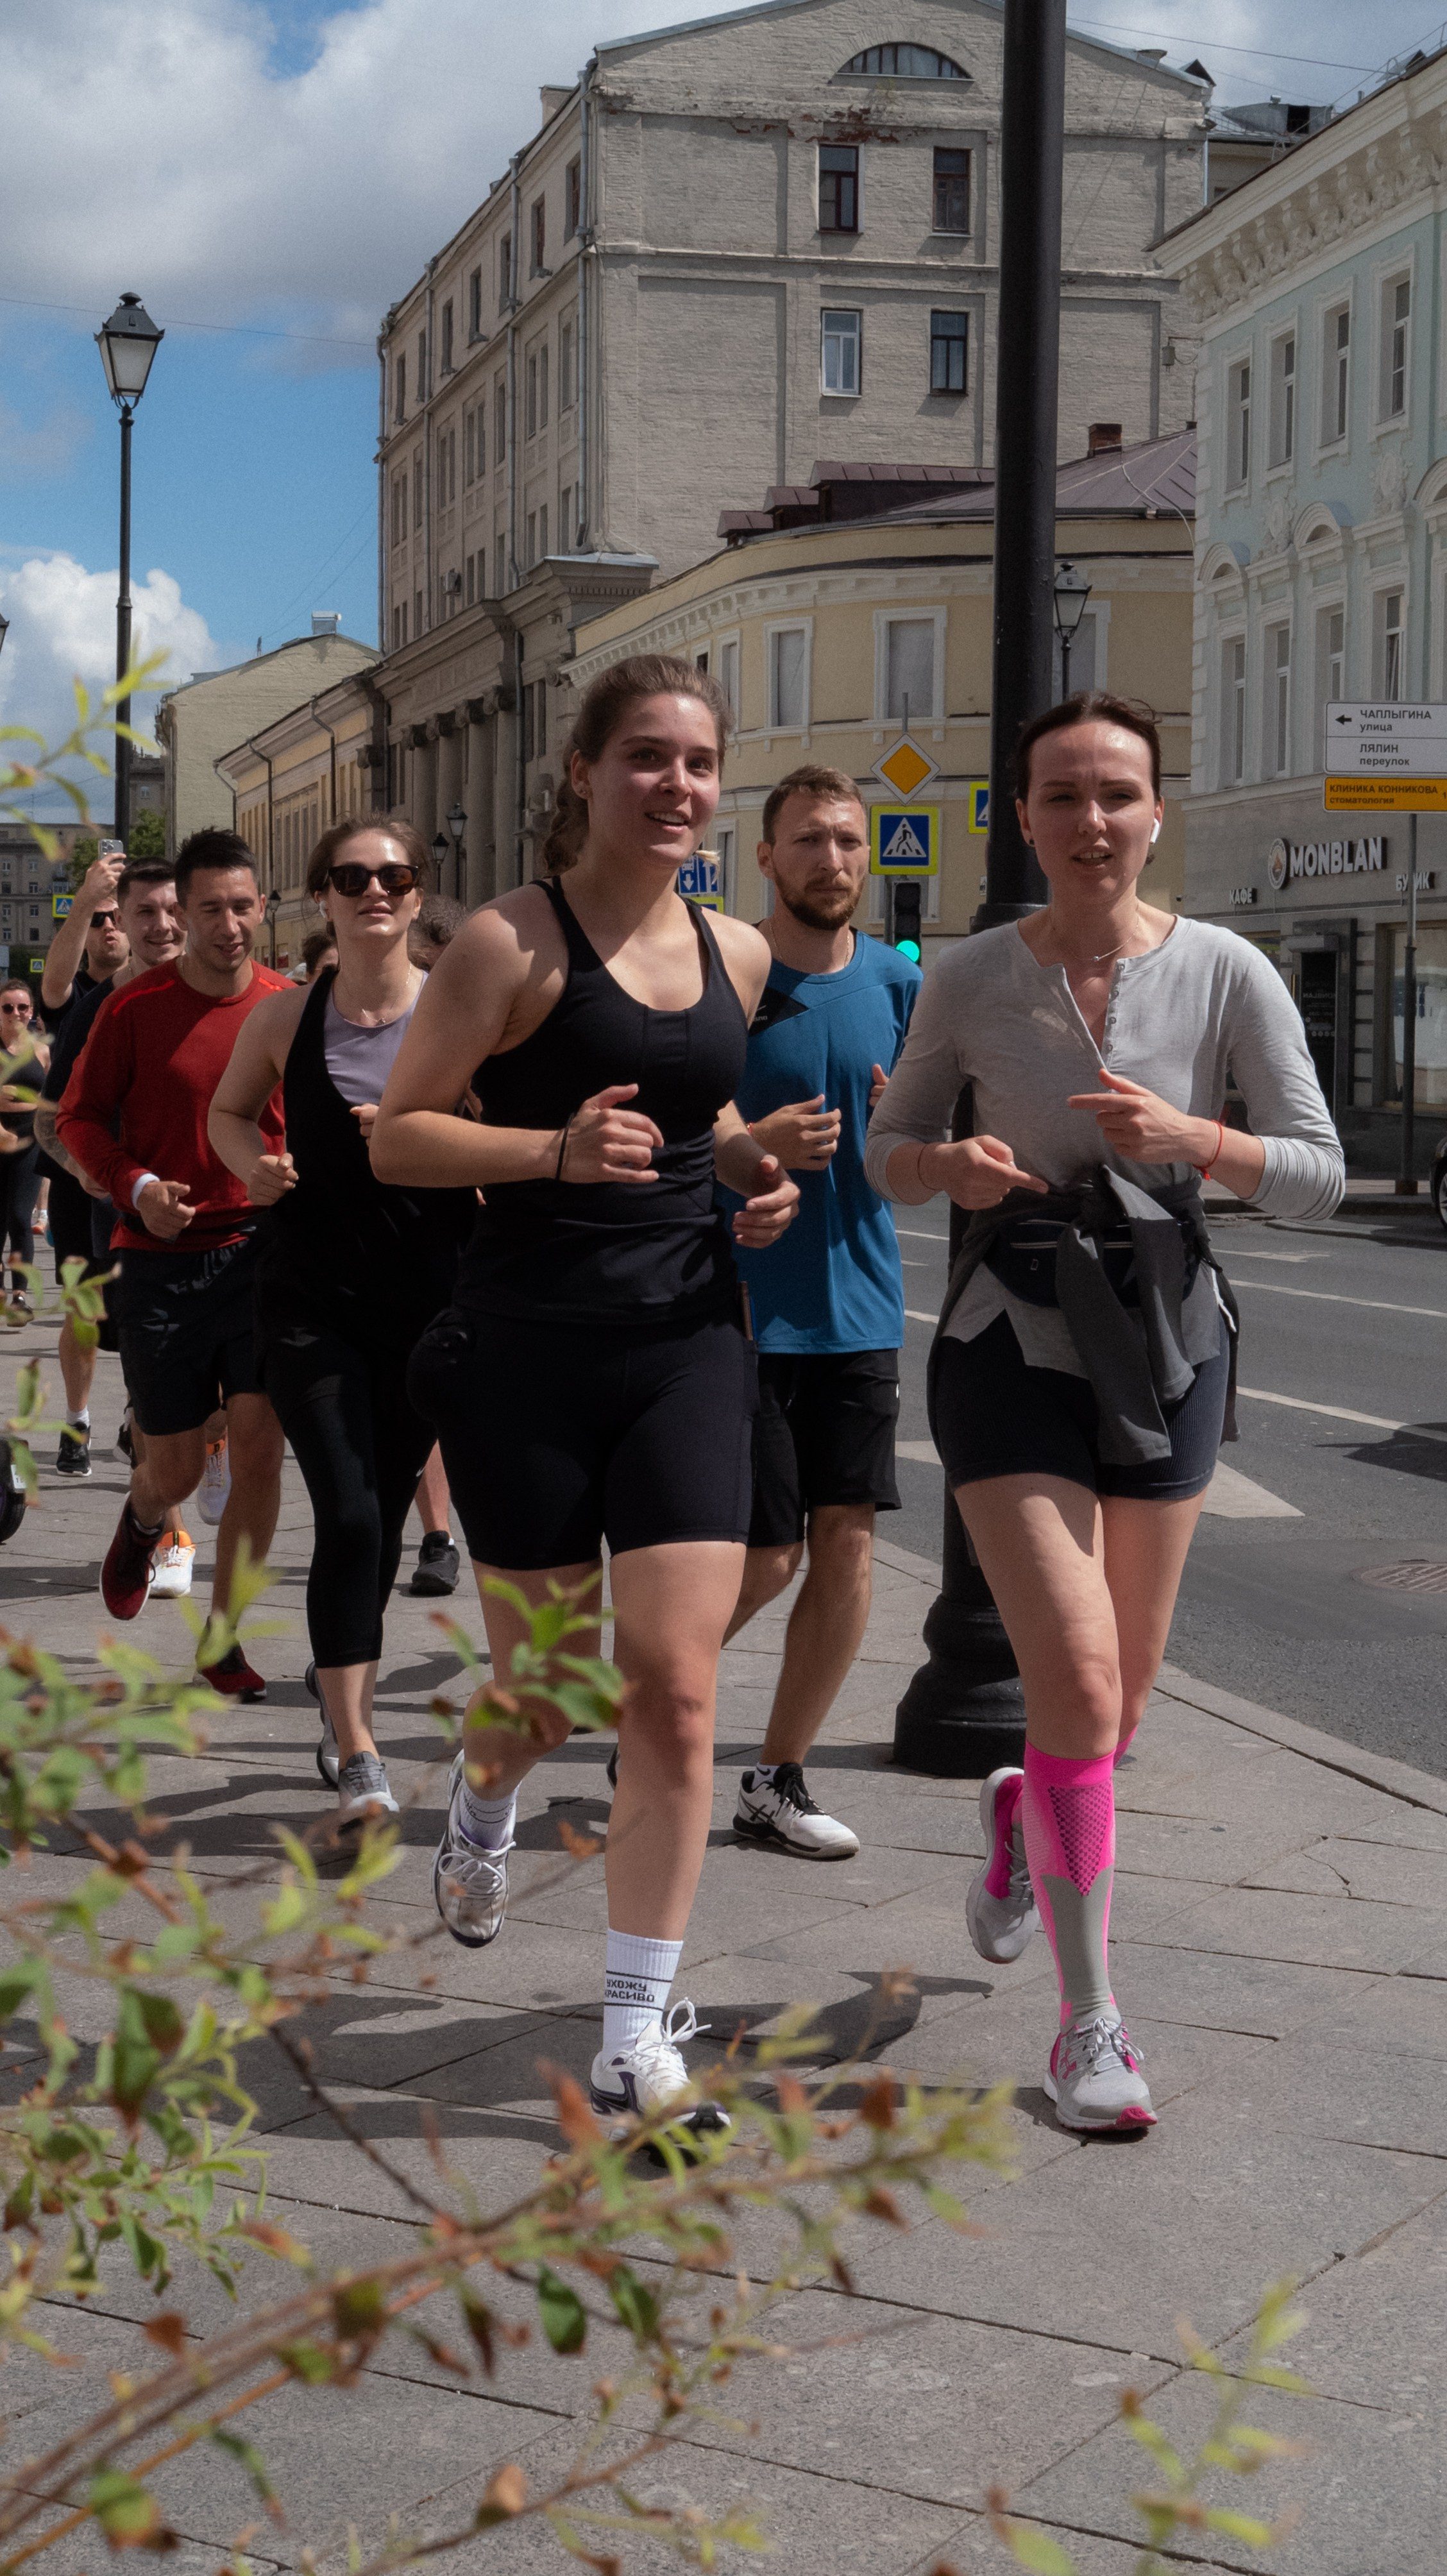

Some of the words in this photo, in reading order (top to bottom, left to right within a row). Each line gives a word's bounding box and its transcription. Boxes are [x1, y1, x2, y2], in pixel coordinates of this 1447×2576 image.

[1360, 709, 1432, 719] ЧАПЛЫГИНА
[1360, 724, 1392, 733] улица
[1360, 744, 1398, 753] ЛЯЛИН
[1360, 758, 1410, 767] переулок
[1330, 784, 1375, 793] КЛИНИКА
[1378, 785, 1438, 793] КОННИКОВА
[1290, 836, 1382, 877] MONBLAN
[1396, 872, 1430, 892] БУИК
[1229, 887, 1253, 904] КАФЕ
[606, 1978, 647, 1992] УХОЖУ
